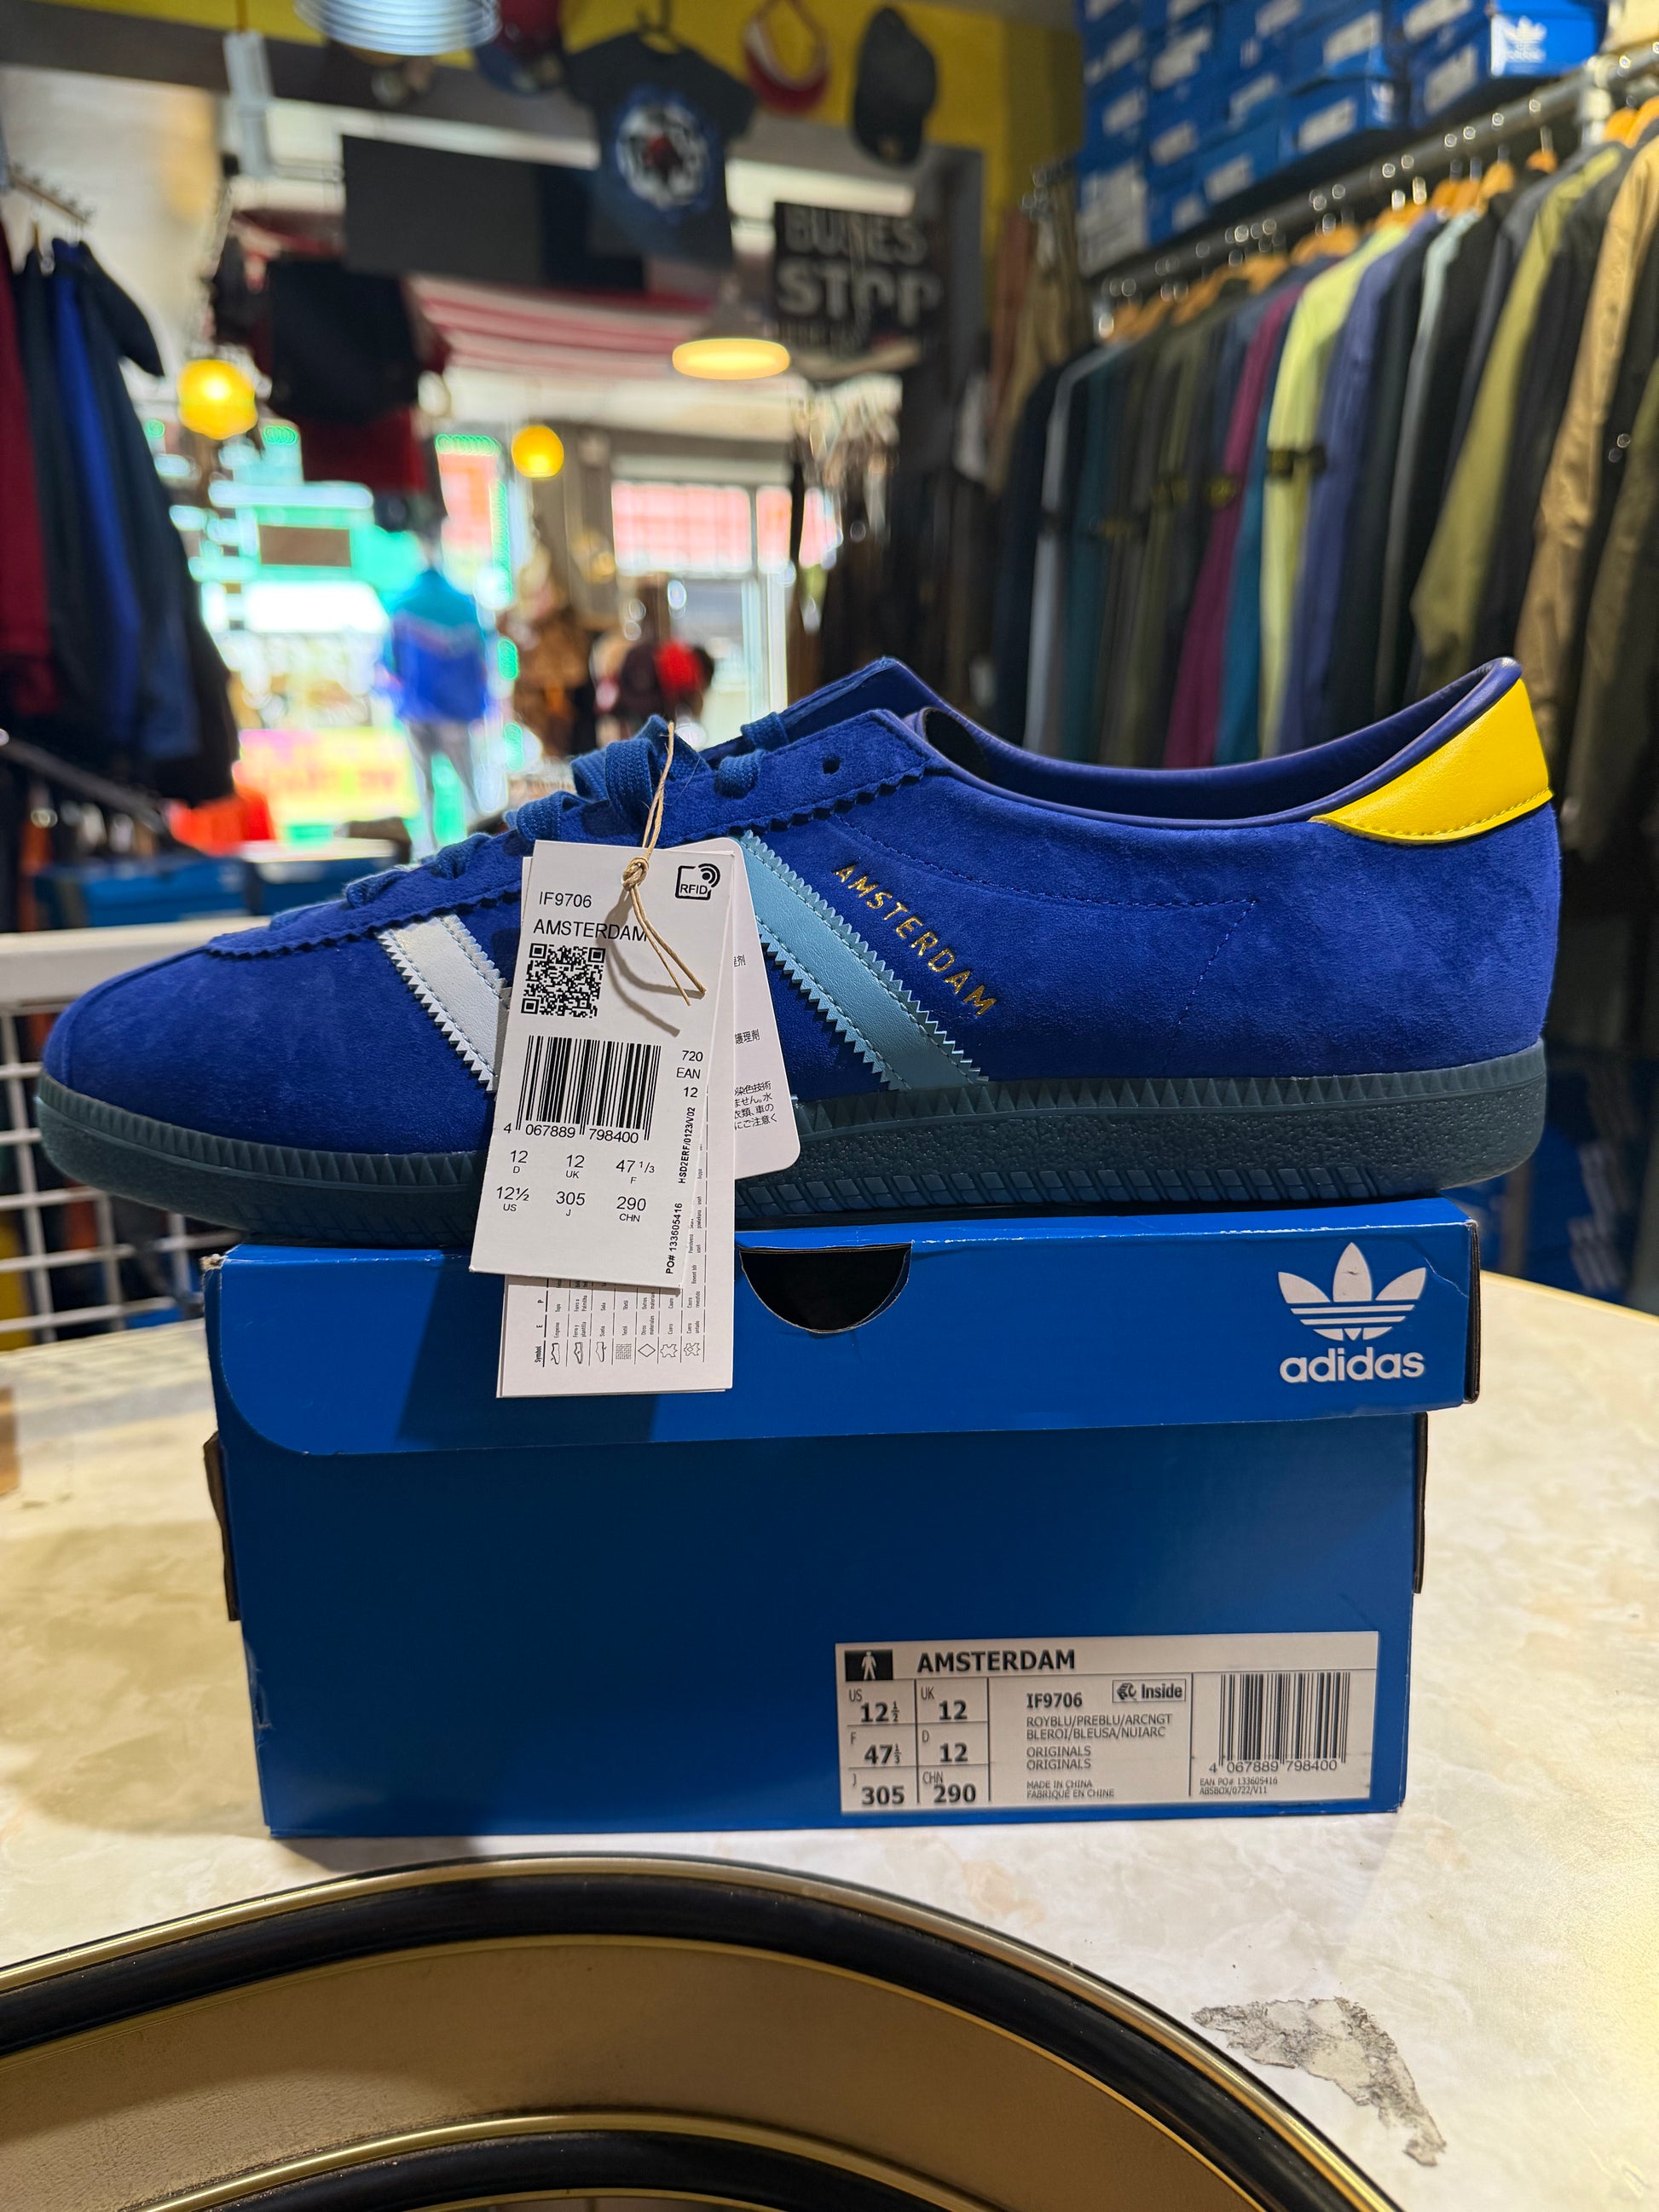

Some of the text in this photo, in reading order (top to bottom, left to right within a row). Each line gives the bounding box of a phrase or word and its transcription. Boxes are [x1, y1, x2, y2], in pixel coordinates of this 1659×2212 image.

[680, 884, 708, 895] RFID
[539, 891, 592, 909] IF9706
[533, 918, 647, 942] AMSTERDAM
[832, 863, 997, 1016] AMSTERDAM
[682, 1050, 703, 1062] 720
[676, 1067, 701, 1079] EAN
[683, 1087, 698, 1098] 12
[503, 1123, 639, 1144] 4 067889 798400
[678, 1107, 696, 1183] HSD2ERF/0123/V02
[510, 1150, 529, 1164] 12
[566, 1154, 585, 1169] 12
[616, 1159, 635, 1173] 47
[565, 1170, 580, 1179] UK
[556, 1192, 586, 1206] 305
[616, 1196, 646, 1211] 290
[503, 1204, 517, 1212] US
[619, 1214, 640, 1222] CHN
[666, 1203, 683, 1274] PO# 133605416
[1280, 1346, 1425, 1383] adidas
[916, 1649, 1075, 1673] AMSTERDAM
[848, 1686, 934, 1701] US UK
[1026, 1683, 1182, 1708] IF9706 Inside
[939, 1700, 968, 1720] 12
[1026, 1713, 1172, 1728] ROYBLU/PREBLU/ARCNGT
[851, 1730, 929, 1744] F D
[1026, 1726, 1165, 1741] BLEROI/BLEUSA/NUIARC
[939, 1742, 968, 1762] 12
[1026, 1746, 1091, 1758] ORIGINALS
[1026, 1759, 1091, 1770] ORIGINALS
[1209, 1759, 1338, 1773] 4 067889 798400
[922, 1771, 944, 1784] CHN
[1026, 1779, 1092, 1789] MADE IN CHINA
[1199, 1778, 1215, 1787] EAN
[861, 1783, 976, 1805] 305 290
[1026, 1788, 1114, 1799] FABRIQUE EN CHINE
